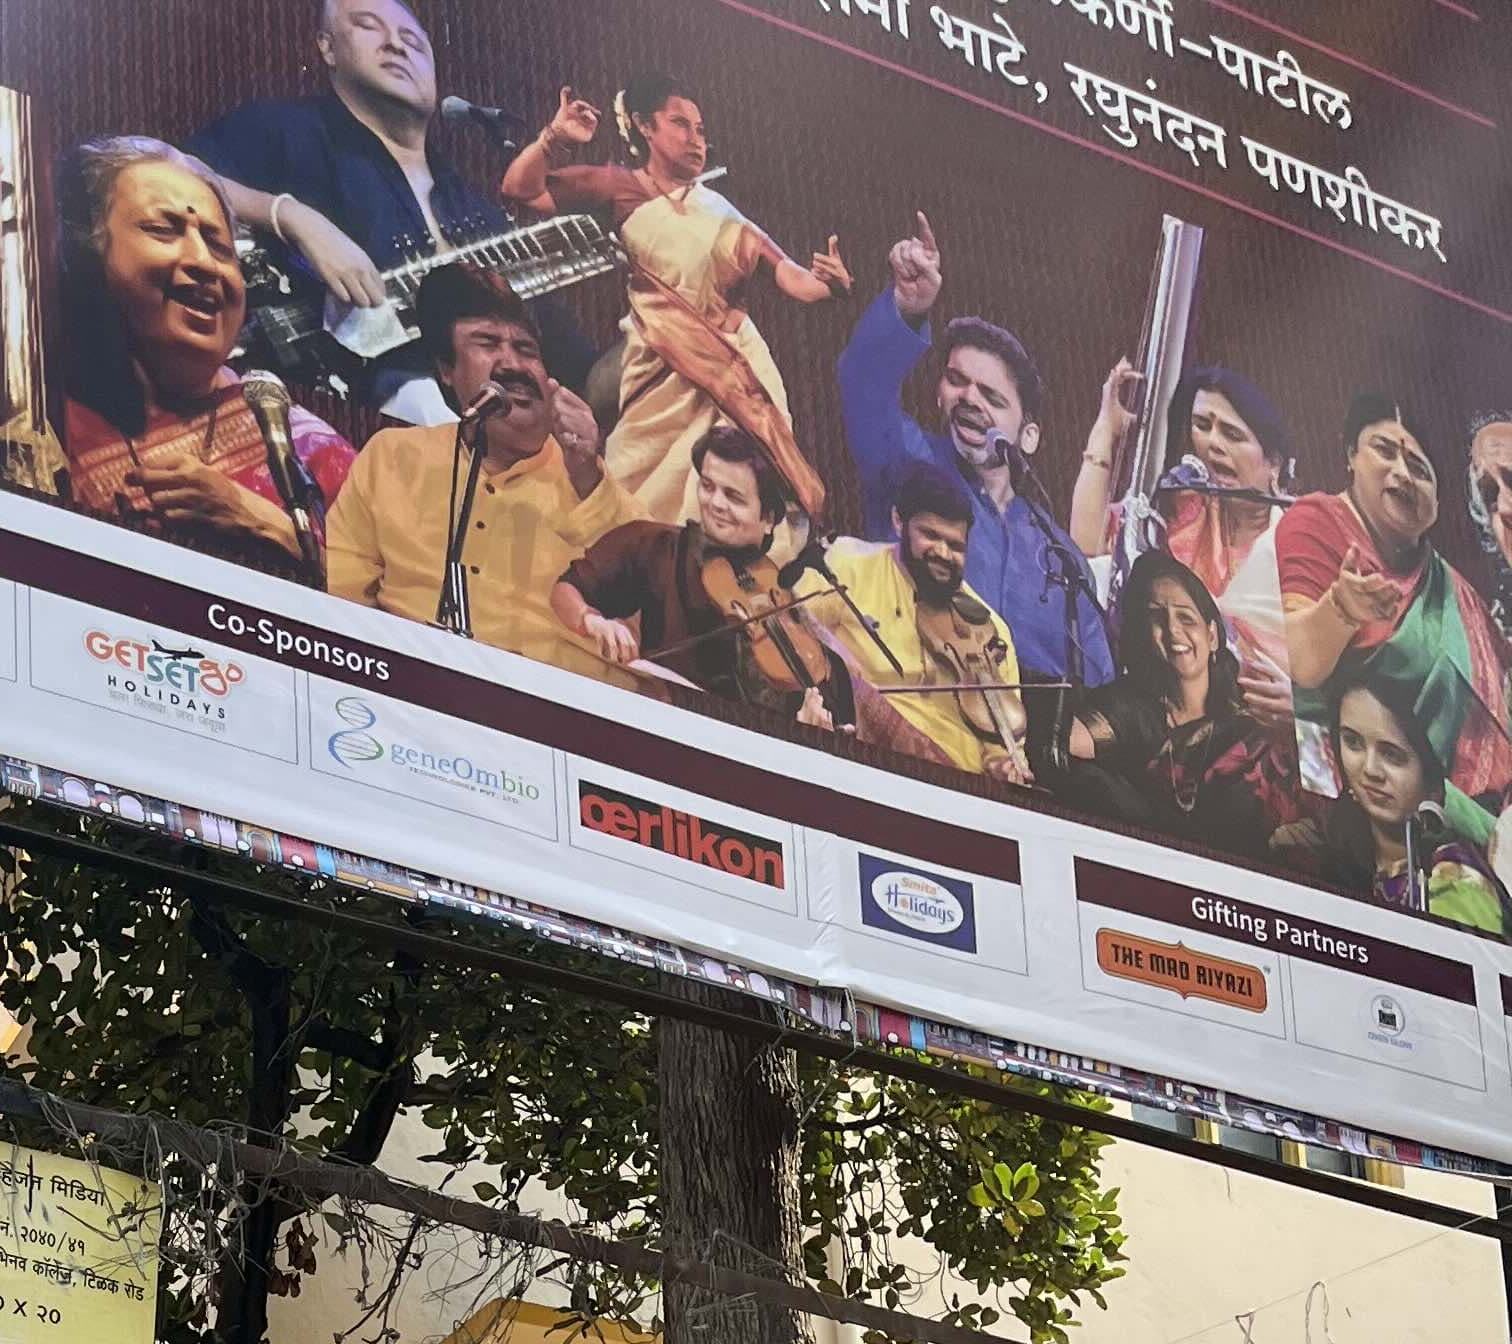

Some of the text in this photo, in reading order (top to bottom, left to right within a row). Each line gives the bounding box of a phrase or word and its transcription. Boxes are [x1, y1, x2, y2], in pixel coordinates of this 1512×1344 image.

[929, 5, 1449, 263] भाटे, रघुनंदन पणशीकर
[207, 602, 392, 682] Co-Sponsors
[107, 674, 226, 719] HOLIDAYS
[391, 743, 540, 801] geneOmbio
[887, 882, 955, 925] Holidays
[1191, 896, 1370, 966] Gifting Partners
[1110, 943, 1144, 971] THE
[1149, 950, 1190, 981] MAD
[50, 1175, 106, 1206] मिडिया
[32, 1257, 77, 1288] कॉलेज,
[83, 1268, 119, 1295] टिळक
[124, 1279, 145, 1301] रोड
[37, 1304, 62, 1325] २०
